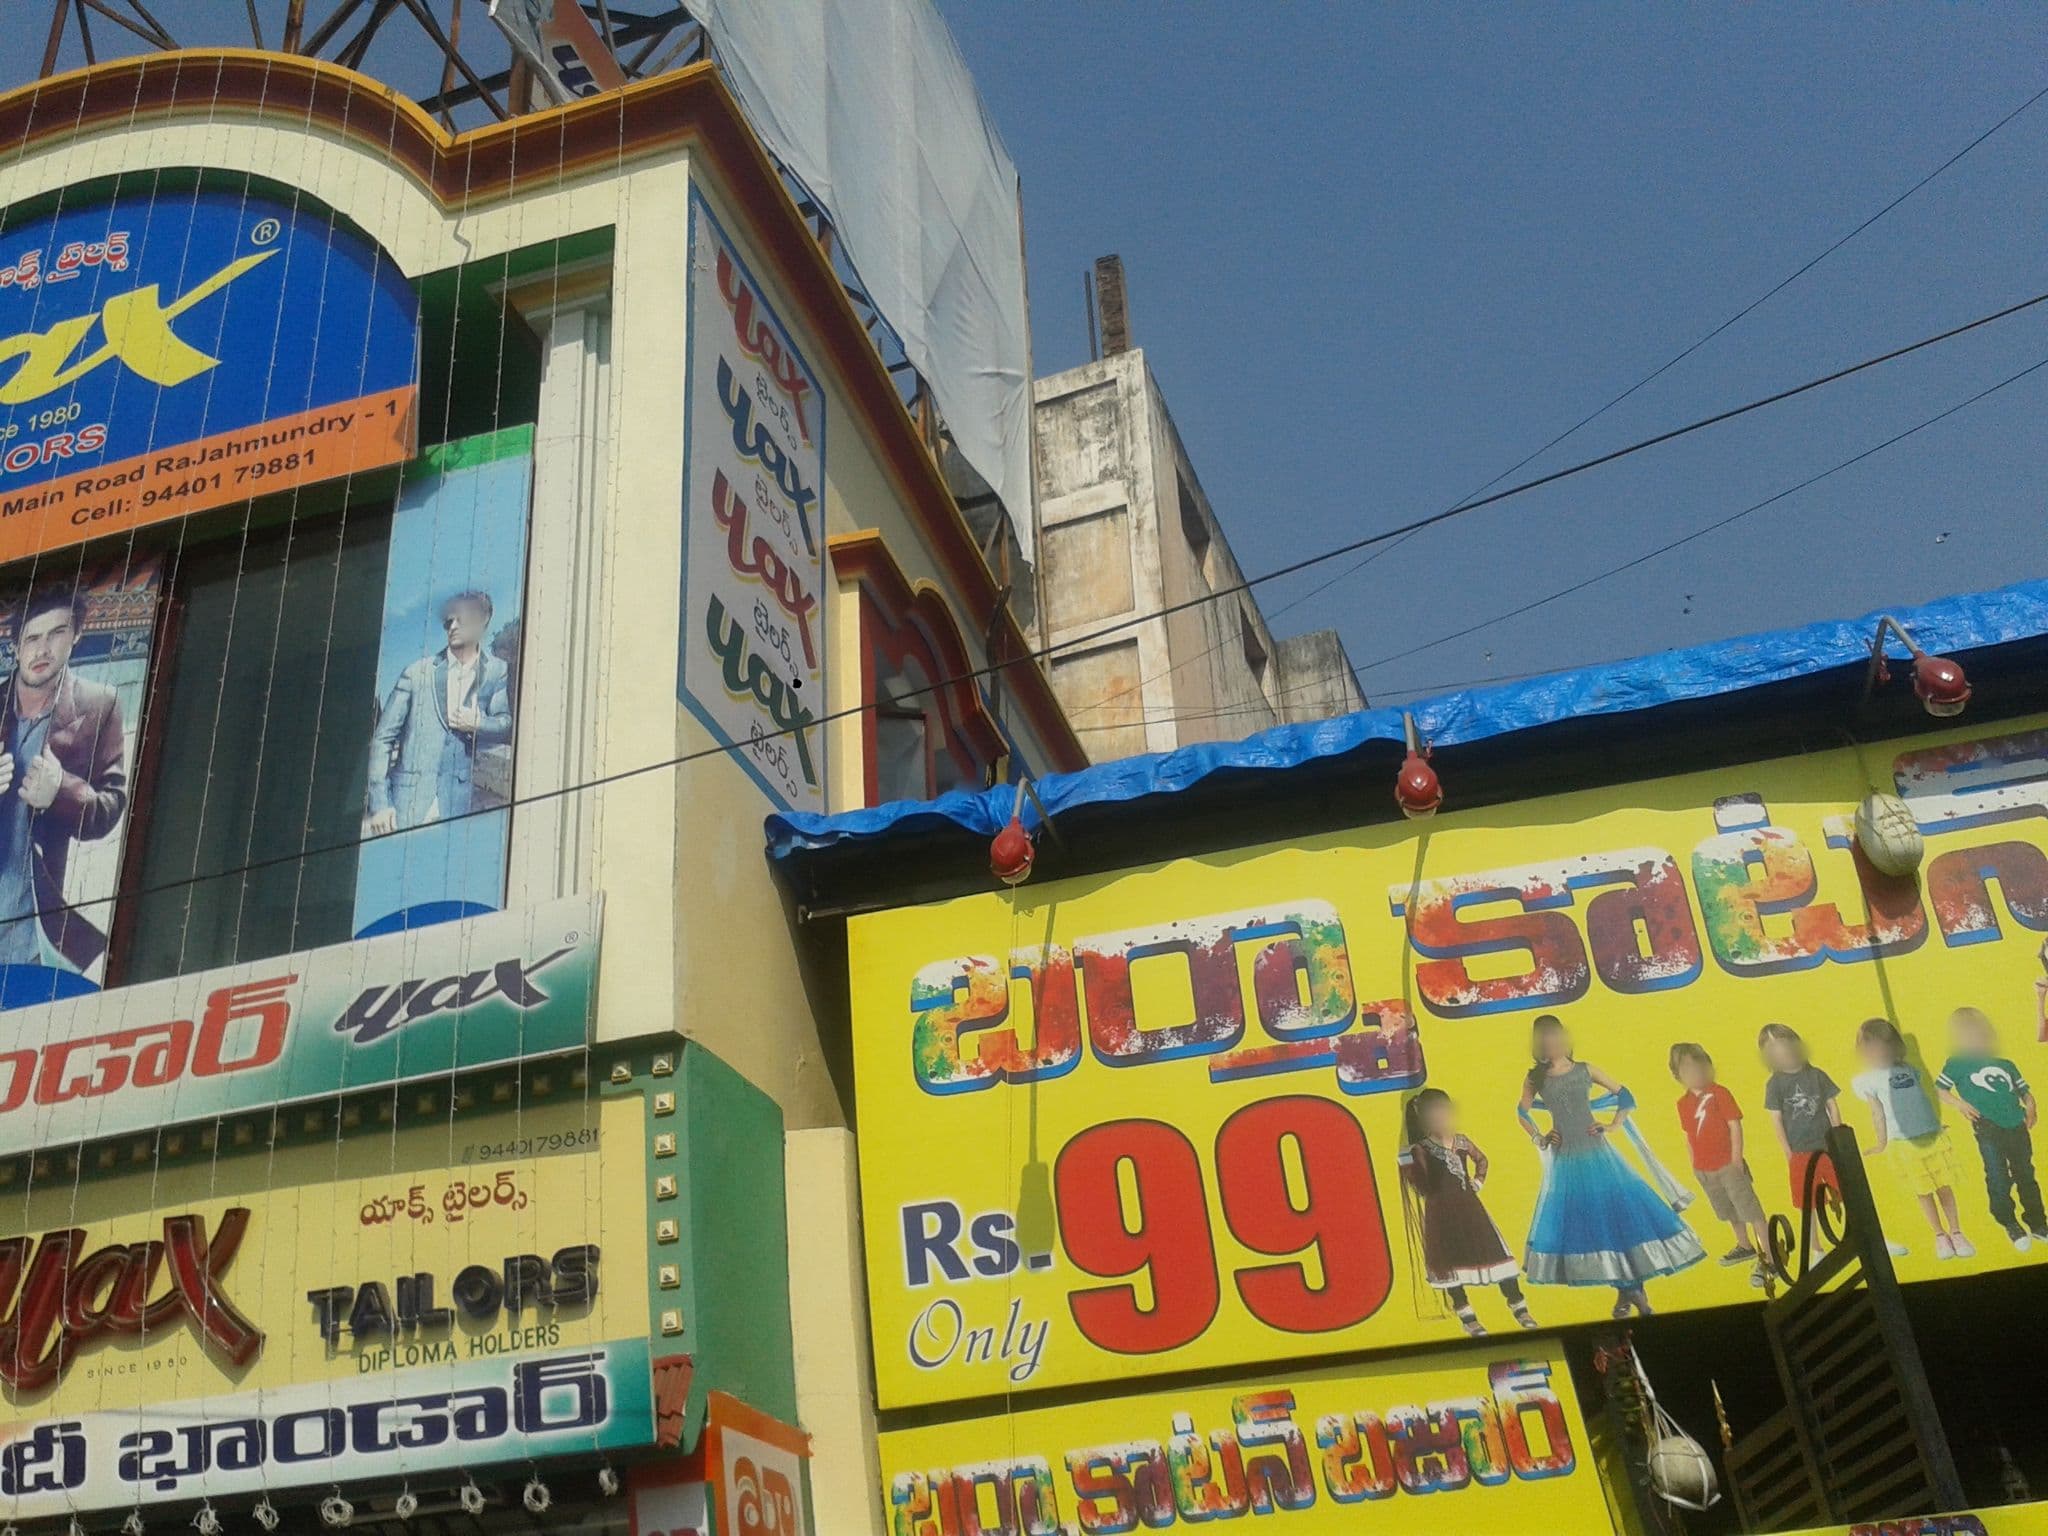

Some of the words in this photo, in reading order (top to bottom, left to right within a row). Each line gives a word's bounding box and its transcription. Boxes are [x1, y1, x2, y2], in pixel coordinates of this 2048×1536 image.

[29, 402, 81, 432] 1980
[2, 488, 65, 518] Main
[74, 465, 145, 498] Road
[384, 399, 397, 417] 1
[70, 496, 132, 526] Cell:
[142, 474, 222, 507] 94401
[235, 448, 316, 485] 79881
[442, 1170, 528, 1222] టైలర్స్
[1055, 1094, 1393, 1355] 99
[307, 1244, 601, 1343] TAILORS
[87, 1364, 137, 1380] SINCE
[146, 1356, 188, 1373] 1980
[359, 1342, 457, 1374] DIPLOMA
[470, 1323, 560, 1357] HOLDERS
[909, 1298, 1051, 1380] Only
